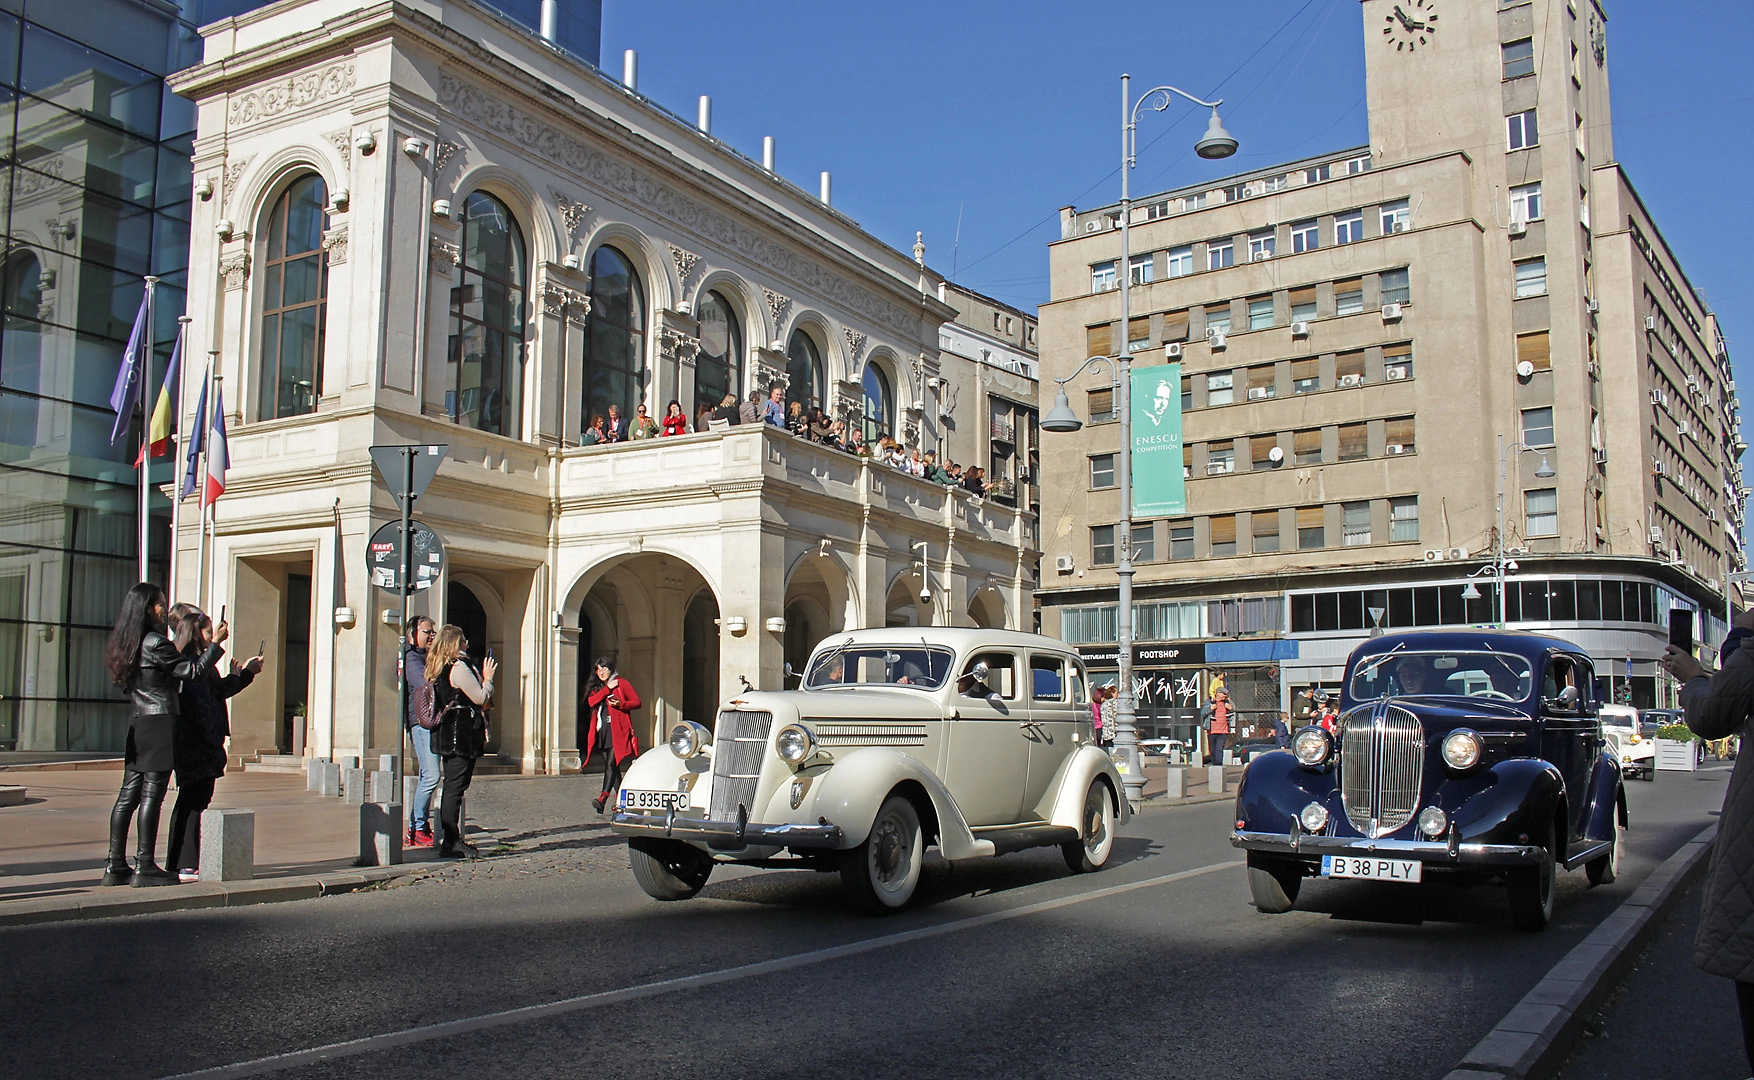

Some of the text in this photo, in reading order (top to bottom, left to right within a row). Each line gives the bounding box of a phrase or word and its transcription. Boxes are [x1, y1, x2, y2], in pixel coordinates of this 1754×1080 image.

[1136, 434, 1178, 445] ENESCU
[1136, 444, 1178, 453] COMPETITION
[1140, 650, 1179, 659] FOOTSHOP
[627, 792, 636, 807] B
[1334, 858, 1413, 879] B 38 PLY
